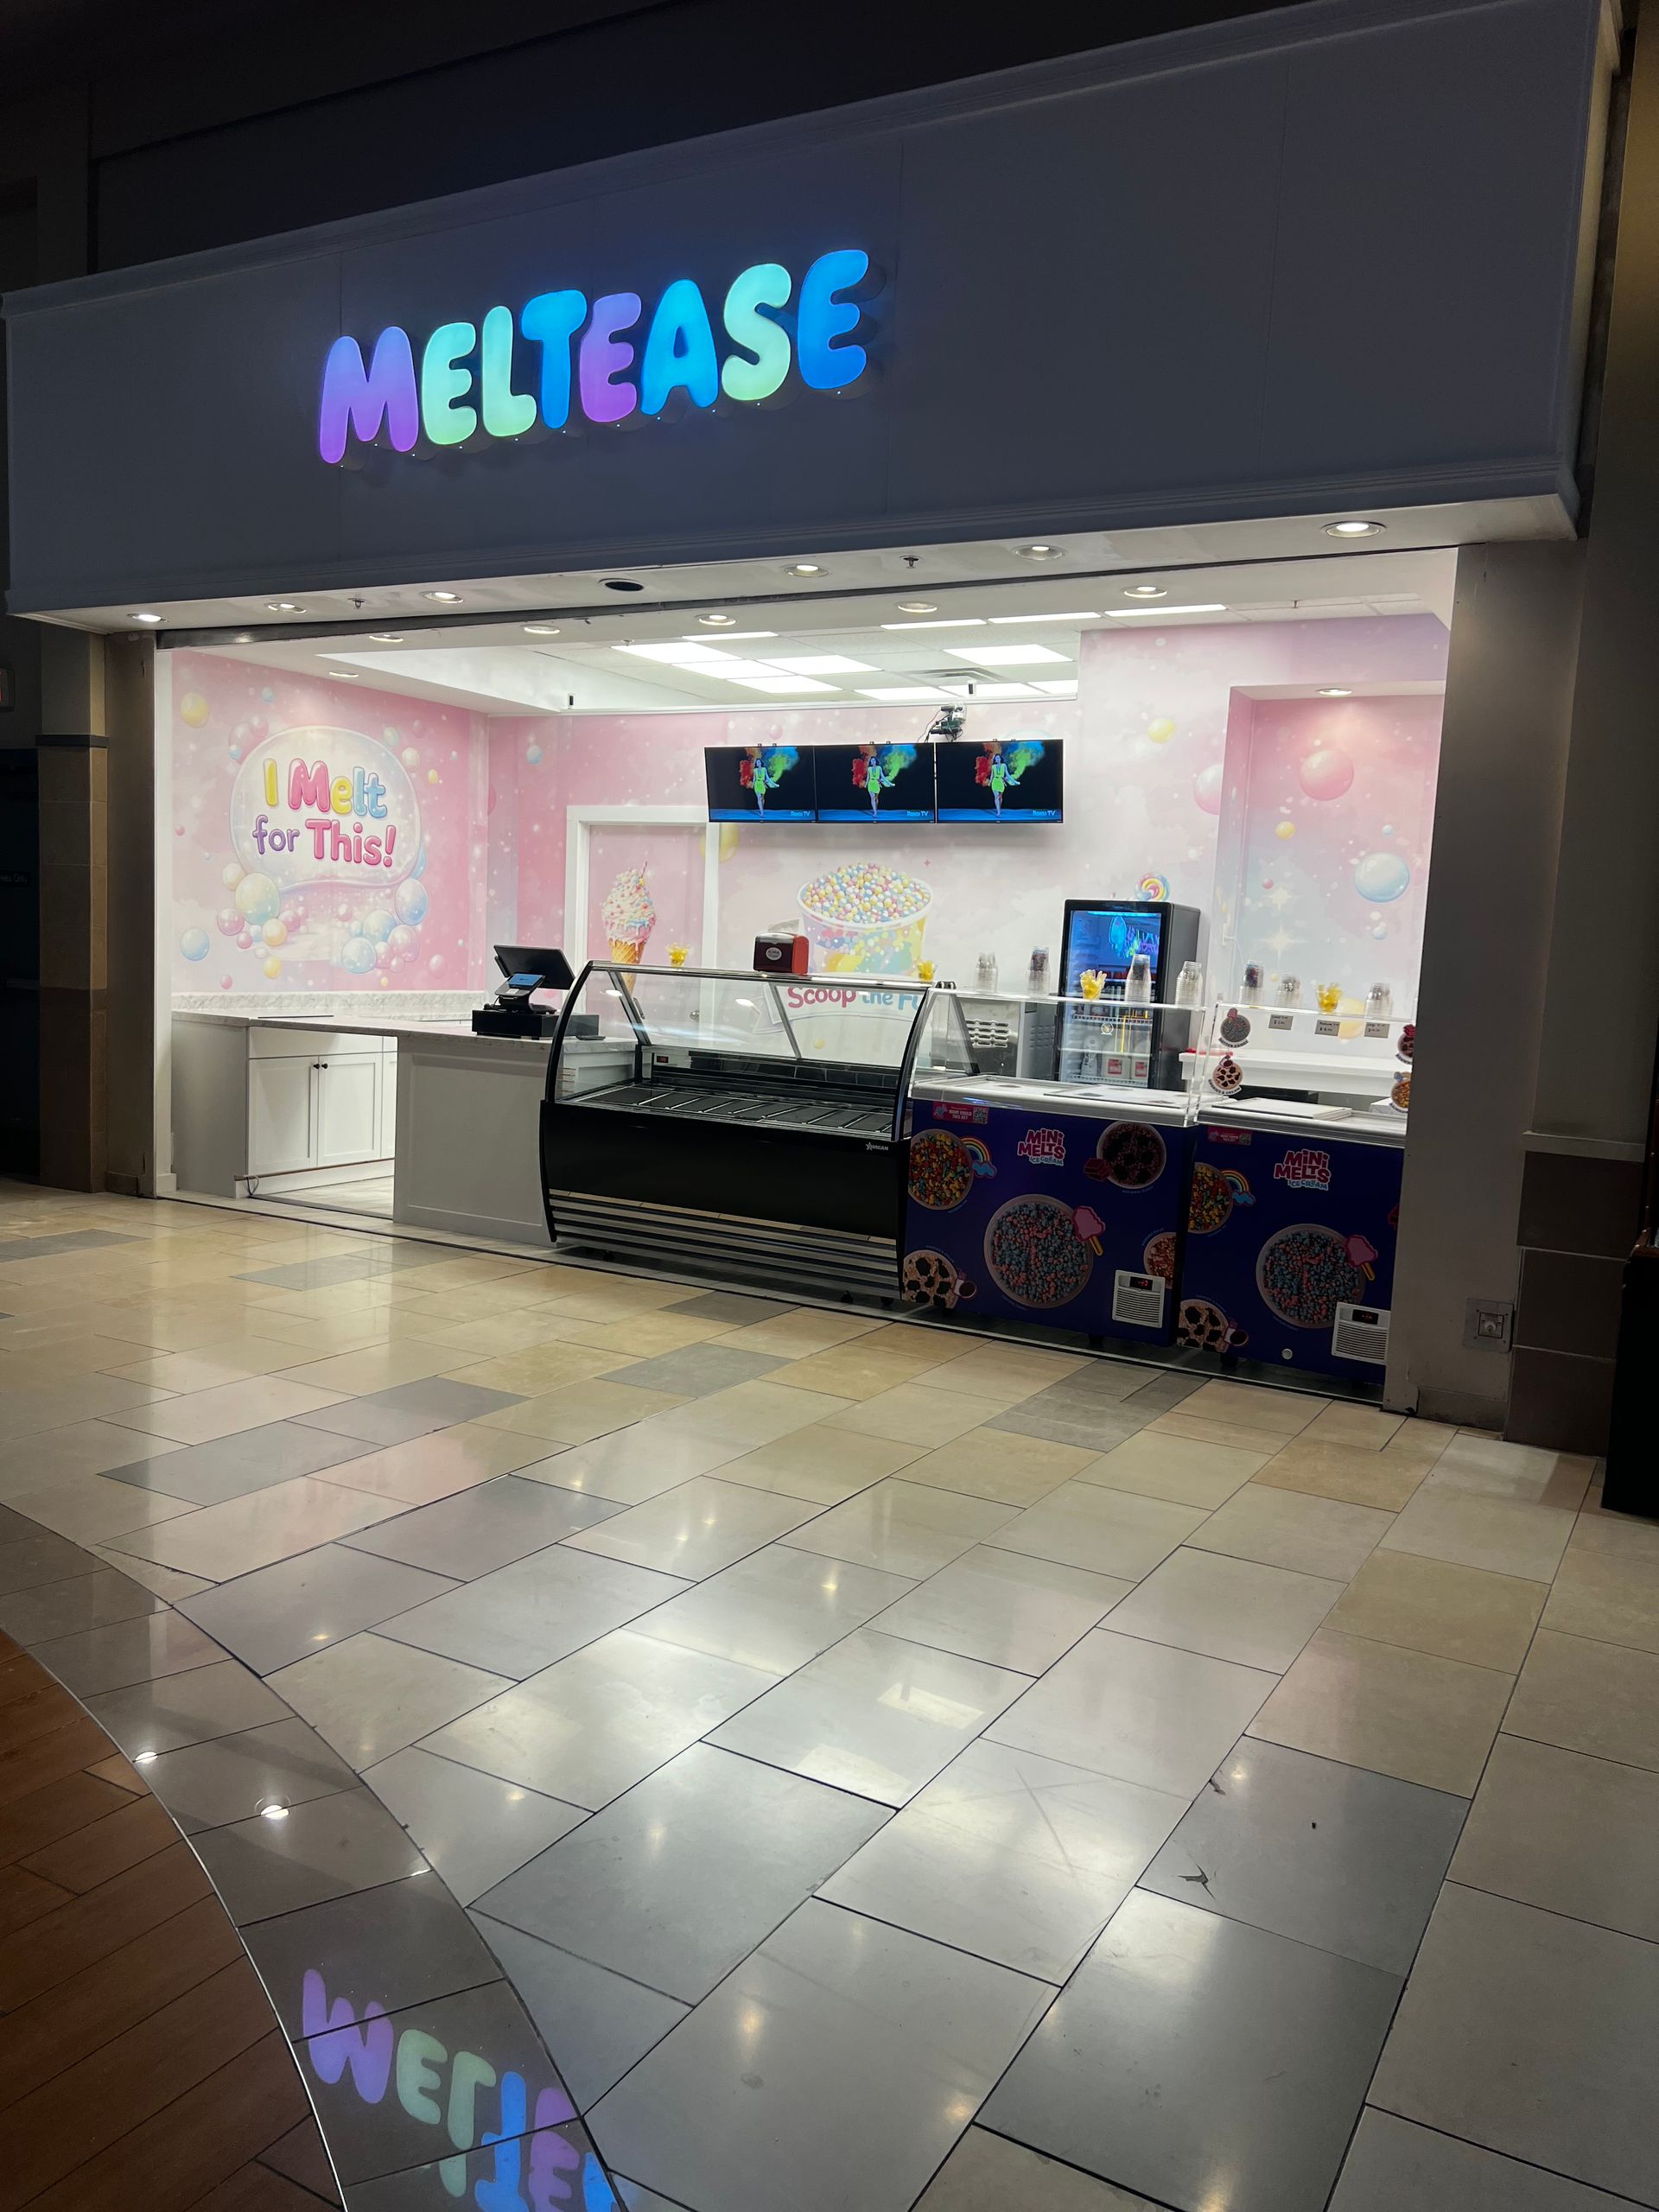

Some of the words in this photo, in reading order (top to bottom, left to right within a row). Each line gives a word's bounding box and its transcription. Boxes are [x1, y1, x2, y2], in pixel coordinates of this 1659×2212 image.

[318, 250, 869, 464] MELTEASE
[263, 758, 278, 806] I
[288, 758, 388, 819] Melt
[252, 815, 300, 855] for
[305, 818, 397, 868] This!
[787, 987, 857, 1008] Scoop
[861, 989, 893, 1006] the
[1017, 1141, 1065, 1160] MELTS
[1274, 1163, 1332, 1184] MELTS
[1300, 1179, 1329, 1191] CREAM
